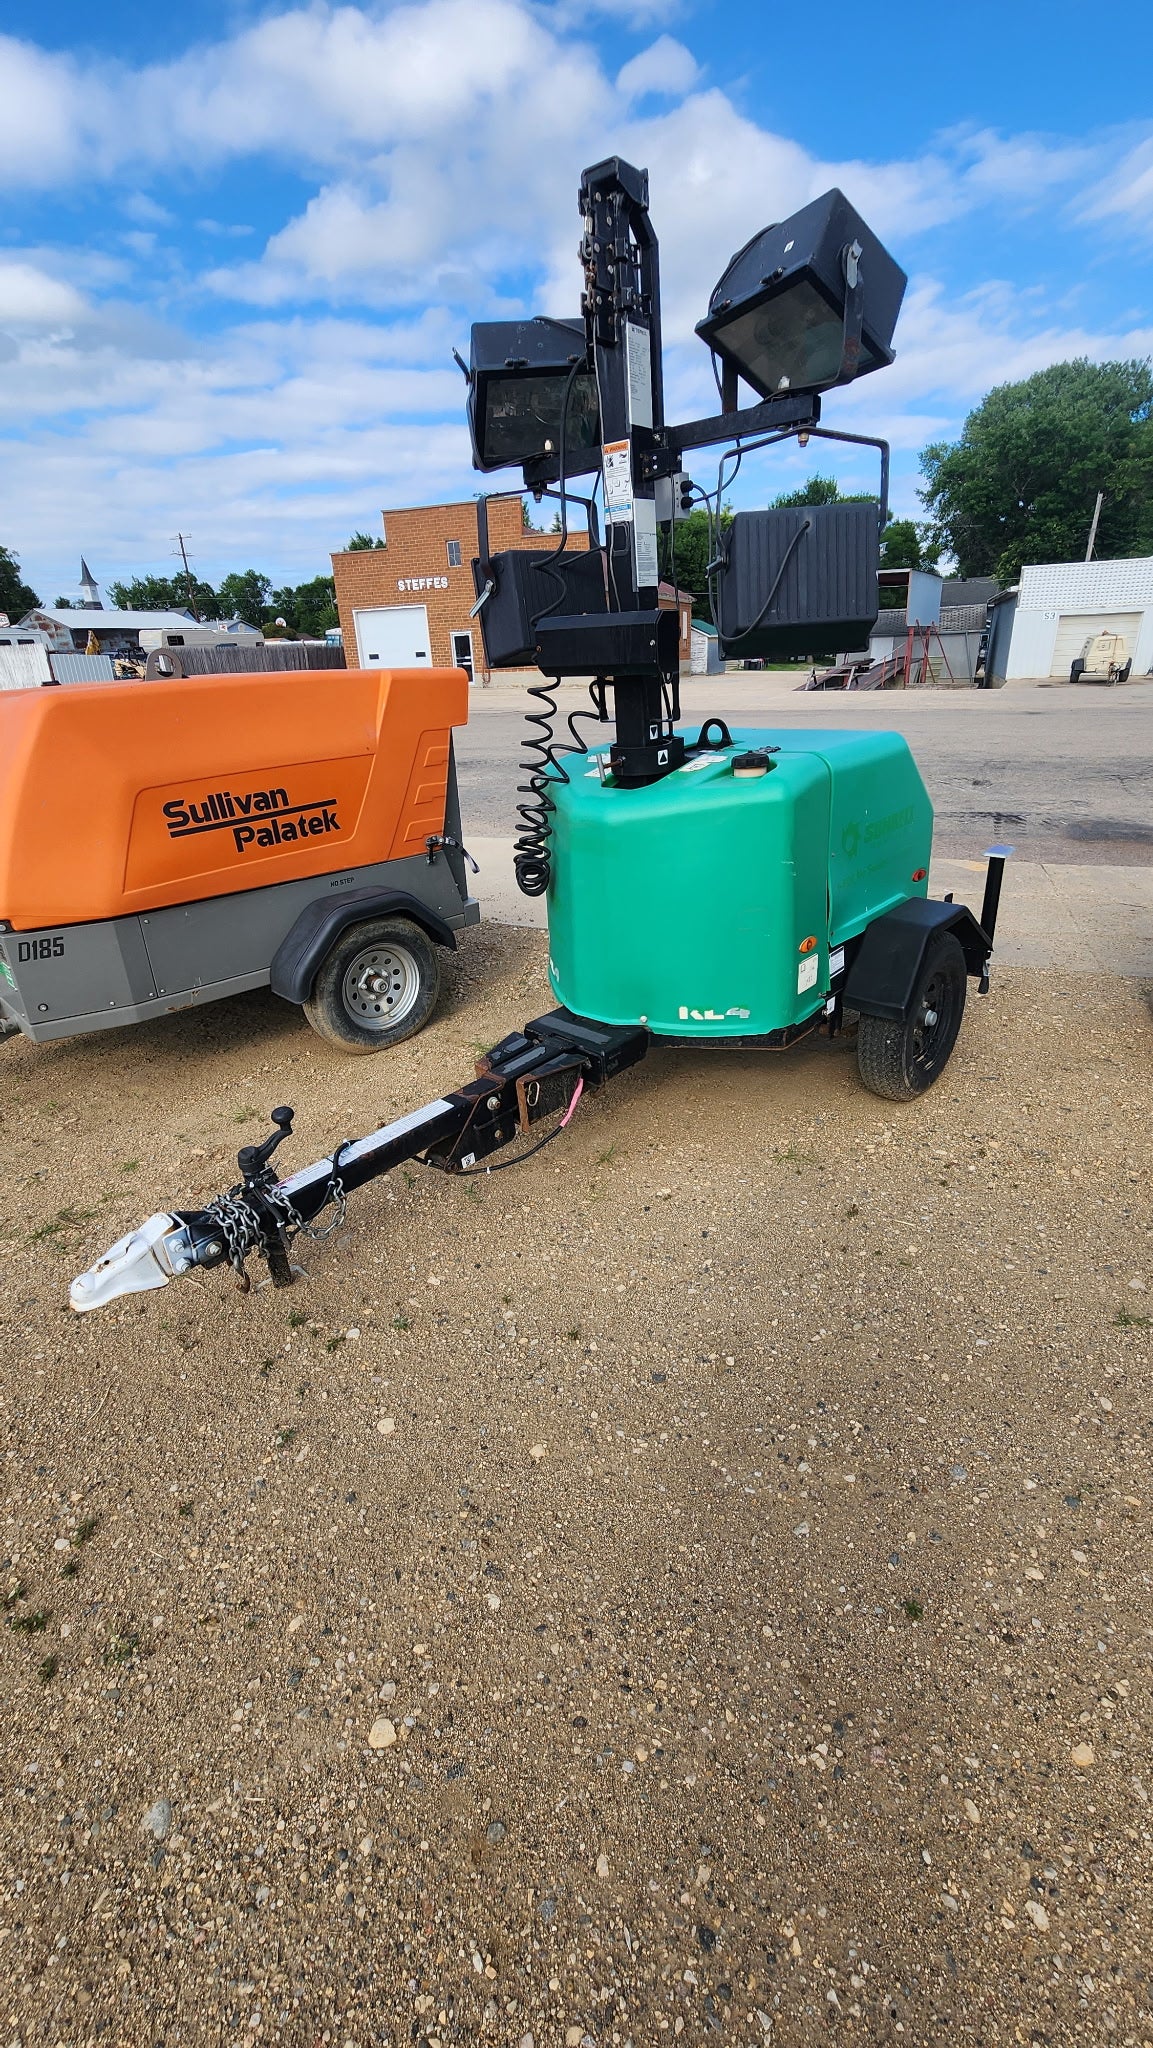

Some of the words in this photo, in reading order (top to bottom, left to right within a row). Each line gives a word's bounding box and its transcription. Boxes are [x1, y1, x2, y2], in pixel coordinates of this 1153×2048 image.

[397, 576, 448, 591] STEFFES
[163, 788, 289, 829] Sullivan
[232, 809, 341, 853] Palatek
[340, 877, 354, 885] STEP
[18, 936, 65, 962] D185
